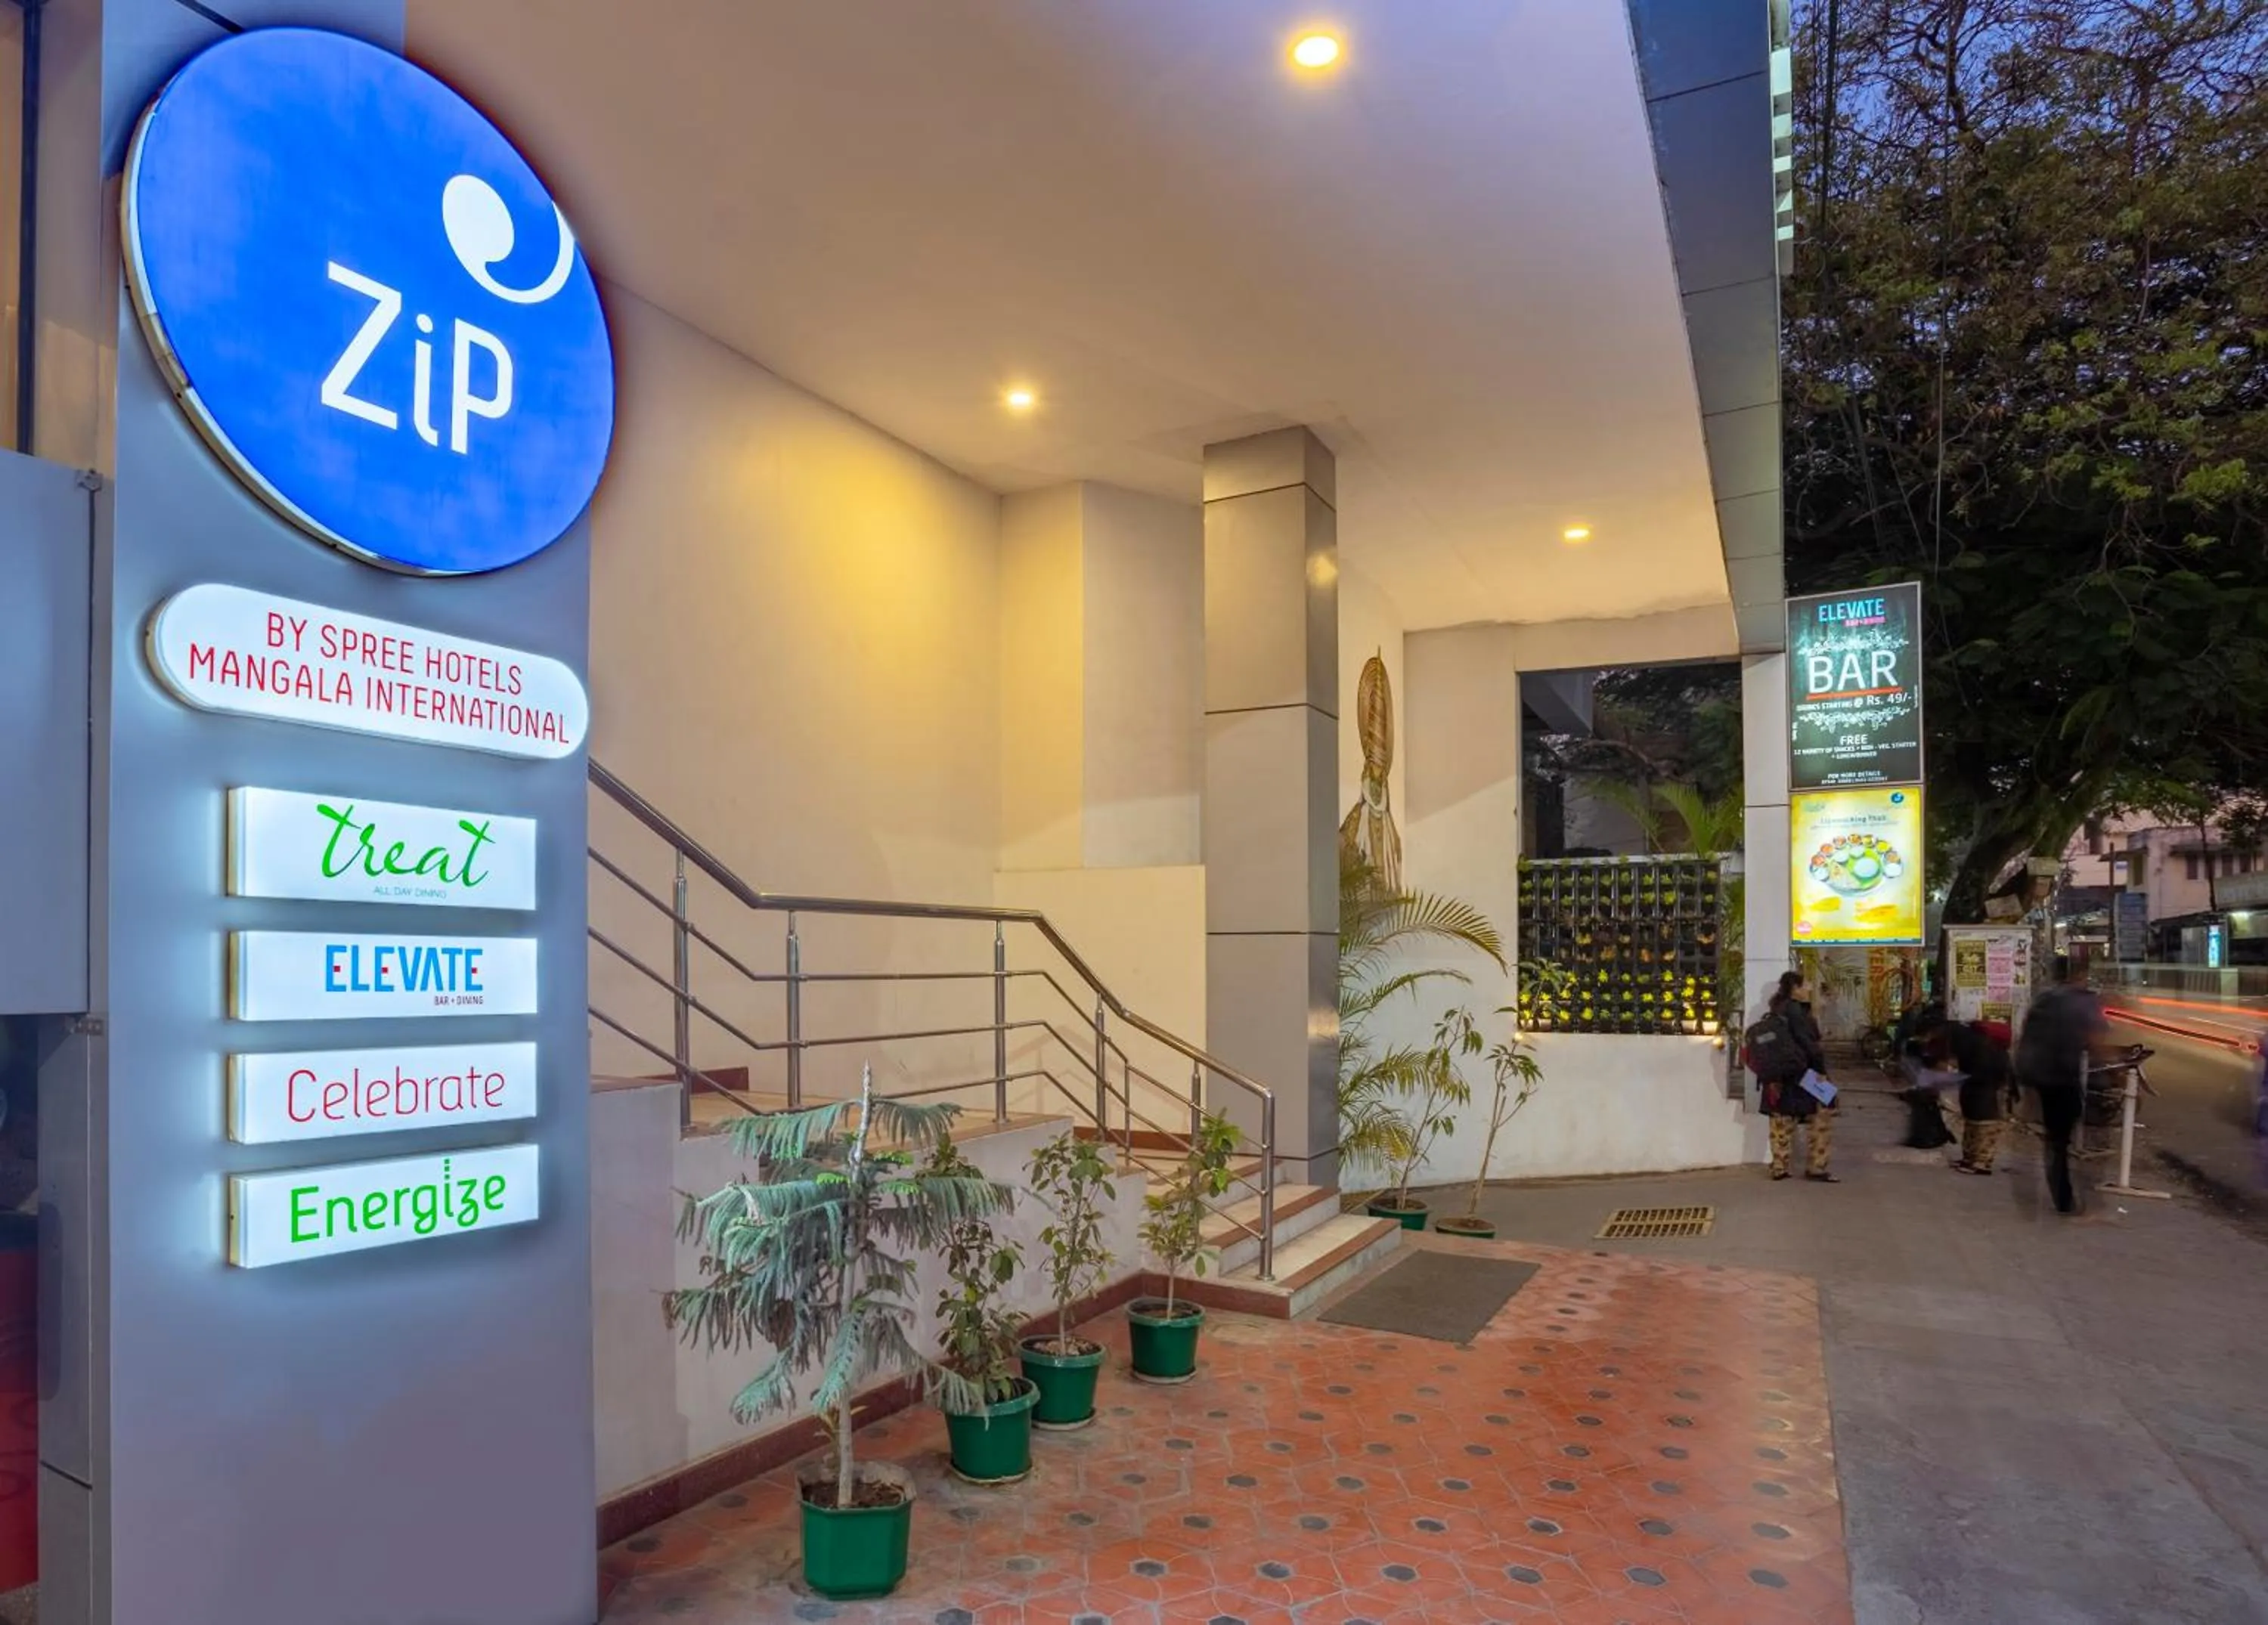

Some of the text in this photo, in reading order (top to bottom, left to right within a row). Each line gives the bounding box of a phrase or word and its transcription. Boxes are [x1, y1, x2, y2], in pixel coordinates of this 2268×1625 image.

[1818, 598, 1885, 622] ELEVATE
[266, 611, 522, 695] BY SPREE HOTELS
[1808, 649, 1898, 694] BAR
[189, 643, 570, 744] MANGALA INTERNATIONAL
[1867, 695, 1883, 705] Rs.
[1887, 692, 1911, 704] 49/-
[1839, 734, 1868, 745] FREE
[316, 803, 496, 888] treat
[373, 886, 447, 899] ALL DAY DINING
[326, 945, 484, 992] ELEVATE
[435, 995, 450, 1006] BAR
[456, 995, 484, 1006] DINING
[288, 1066, 506, 1122] Celebrate
[291, 1158, 507, 1244] Energize
